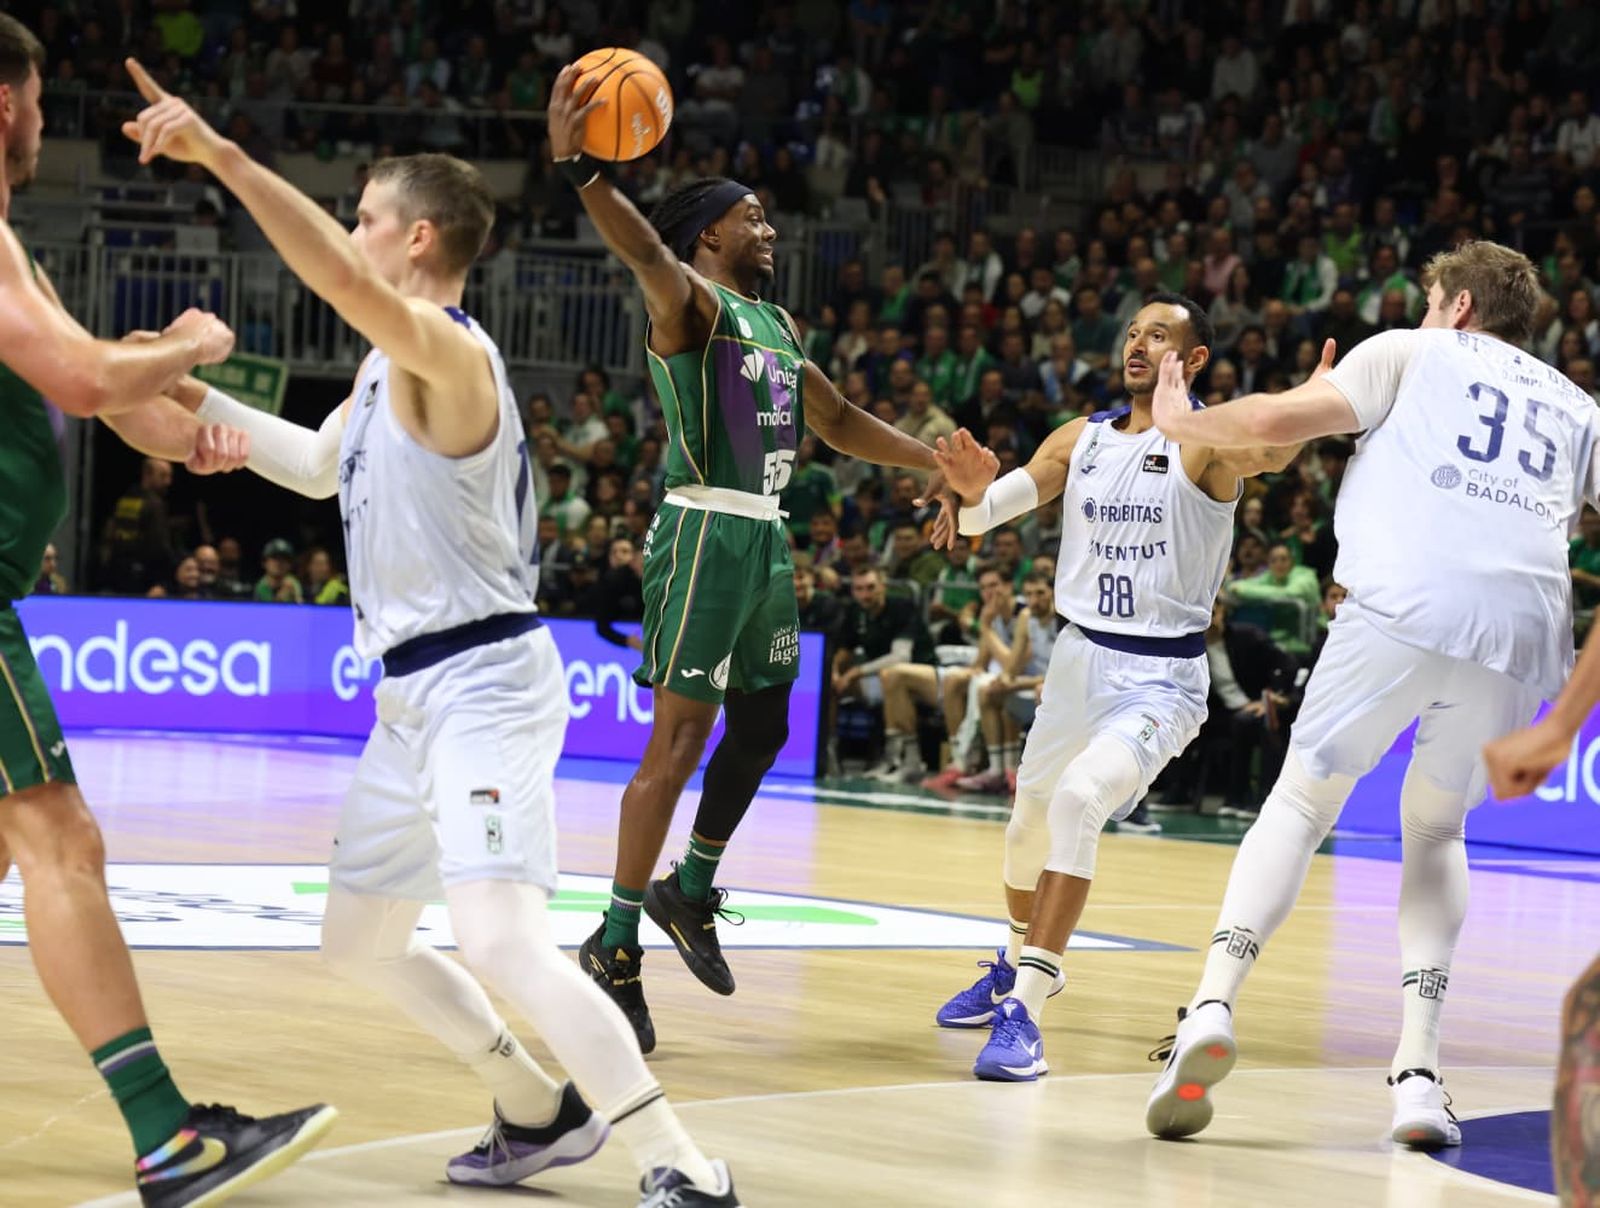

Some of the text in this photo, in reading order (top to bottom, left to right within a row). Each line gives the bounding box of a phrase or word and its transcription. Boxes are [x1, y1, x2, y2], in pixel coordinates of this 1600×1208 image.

[1457, 381, 1570, 482] 35
[763, 449, 796, 496] 55
[1468, 468, 1519, 489] City of
[1090, 540, 1167, 561] VENTUT
[1098, 573, 1135, 617] 88
[28, 619, 270, 696] ndesa
